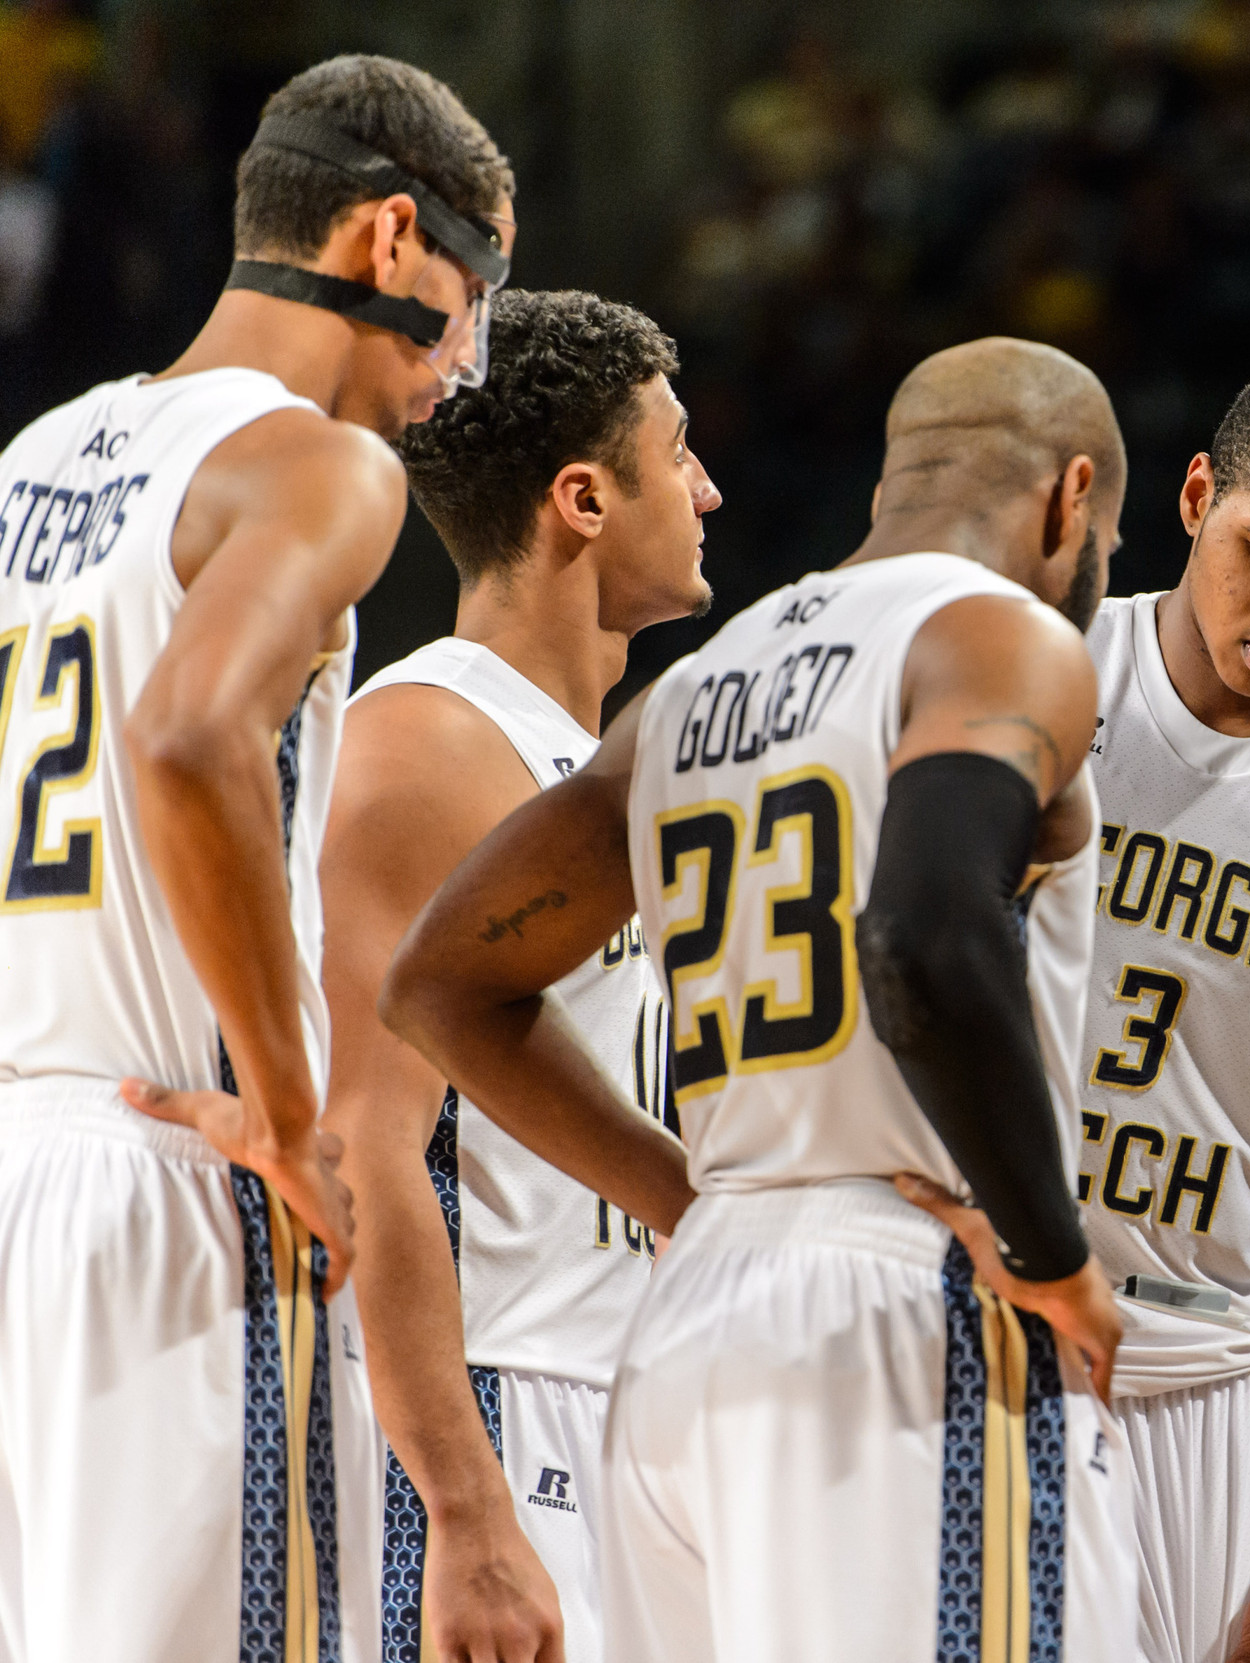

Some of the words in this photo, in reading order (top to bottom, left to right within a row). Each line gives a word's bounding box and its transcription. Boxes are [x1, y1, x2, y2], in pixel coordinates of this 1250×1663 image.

[654, 763, 859, 1106] 23
[1089, 963, 1189, 1093] 3
[1078, 1108, 1234, 1236] CH
[528, 1494, 578, 1513] RUSSELL
[536, 1467, 570, 1499] R
